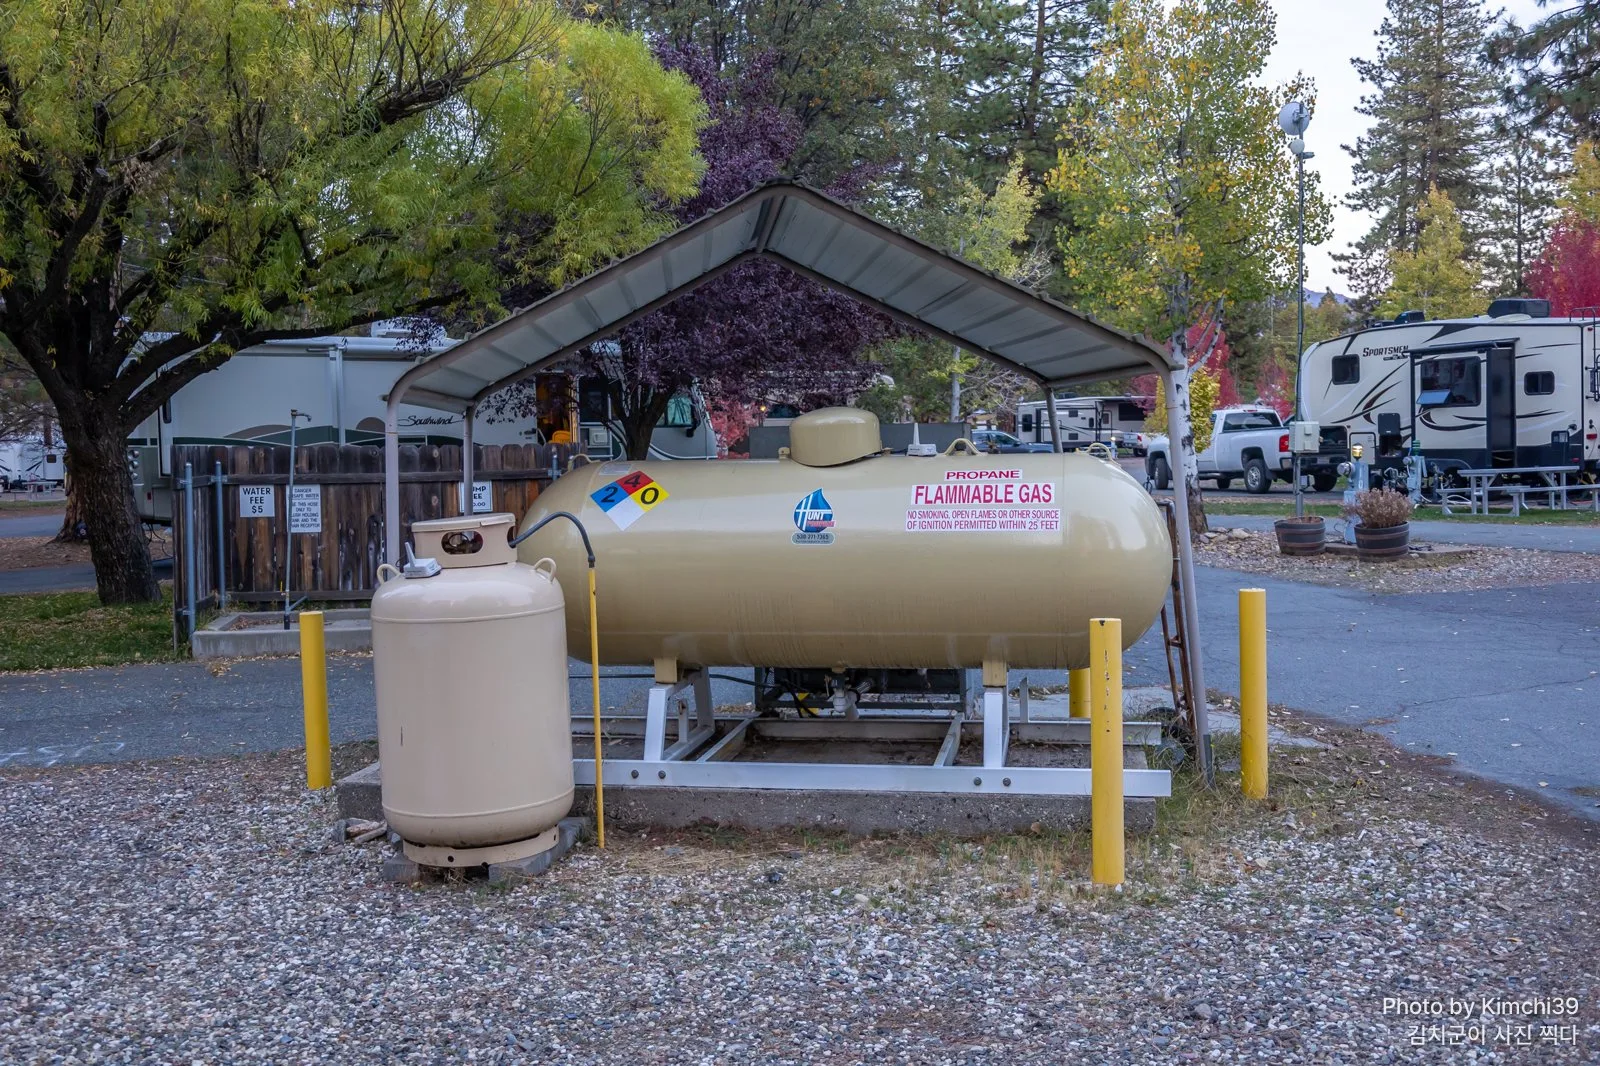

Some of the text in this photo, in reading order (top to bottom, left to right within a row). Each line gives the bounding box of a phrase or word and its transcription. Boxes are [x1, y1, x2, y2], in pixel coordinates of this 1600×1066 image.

[946, 470, 1020, 480] PROPANE
[623, 474, 642, 488] 4
[242, 487, 271, 495] WATER
[601, 486, 618, 503] 2
[640, 487, 660, 505] 0
[914, 484, 1052, 504] FLAMMABLE GAS
[249, 496, 265, 504] FEE
[251, 505, 263, 514] $5
[907, 510, 917, 519] NO
[951, 510, 971, 519] OPEN
[971, 510, 997, 519] FLAMES
[998, 510, 1008, 519] OR
[1009, 510, 1031, 519] OTHER
[1031, 509, 1060, 519] SOURCE
[906, 520, 1060, 530] OF IGNITION PERMITTED WITHIN 25 FEET
